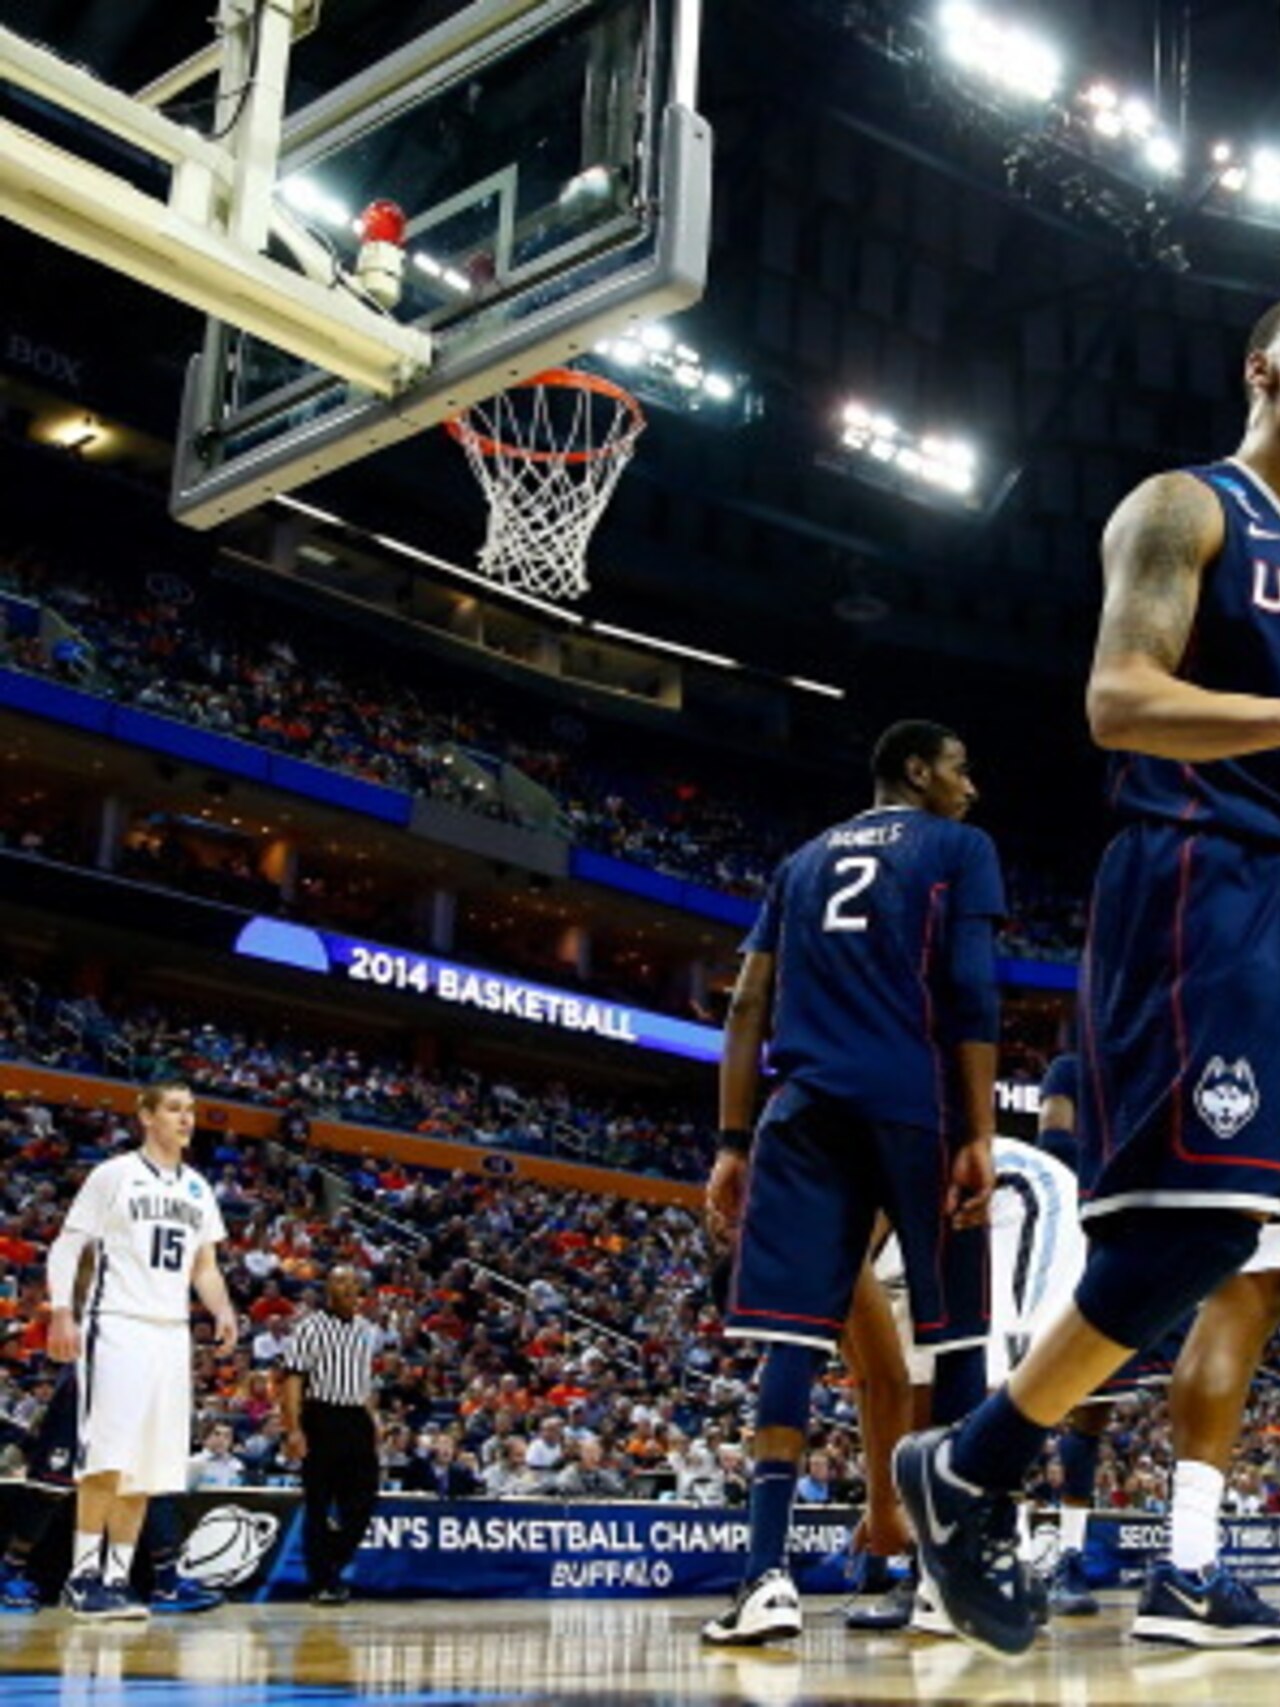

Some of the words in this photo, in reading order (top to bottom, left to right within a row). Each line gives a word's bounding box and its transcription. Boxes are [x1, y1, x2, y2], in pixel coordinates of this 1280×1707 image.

[822, 856, 878, 932] 2
[348, 947, 428, 993] 2014
[437, 967, 638, 1042] BASKETBALL
[150, 1224, 186, 1272] 15
[358, 1516, 430, 1549] EN'S
[438, 1517, 643, 1552] BASKETBALL
[1231, 1526, 1275, 1548] THIRD
[551, 1559, 672, 1588] BUFFALO
